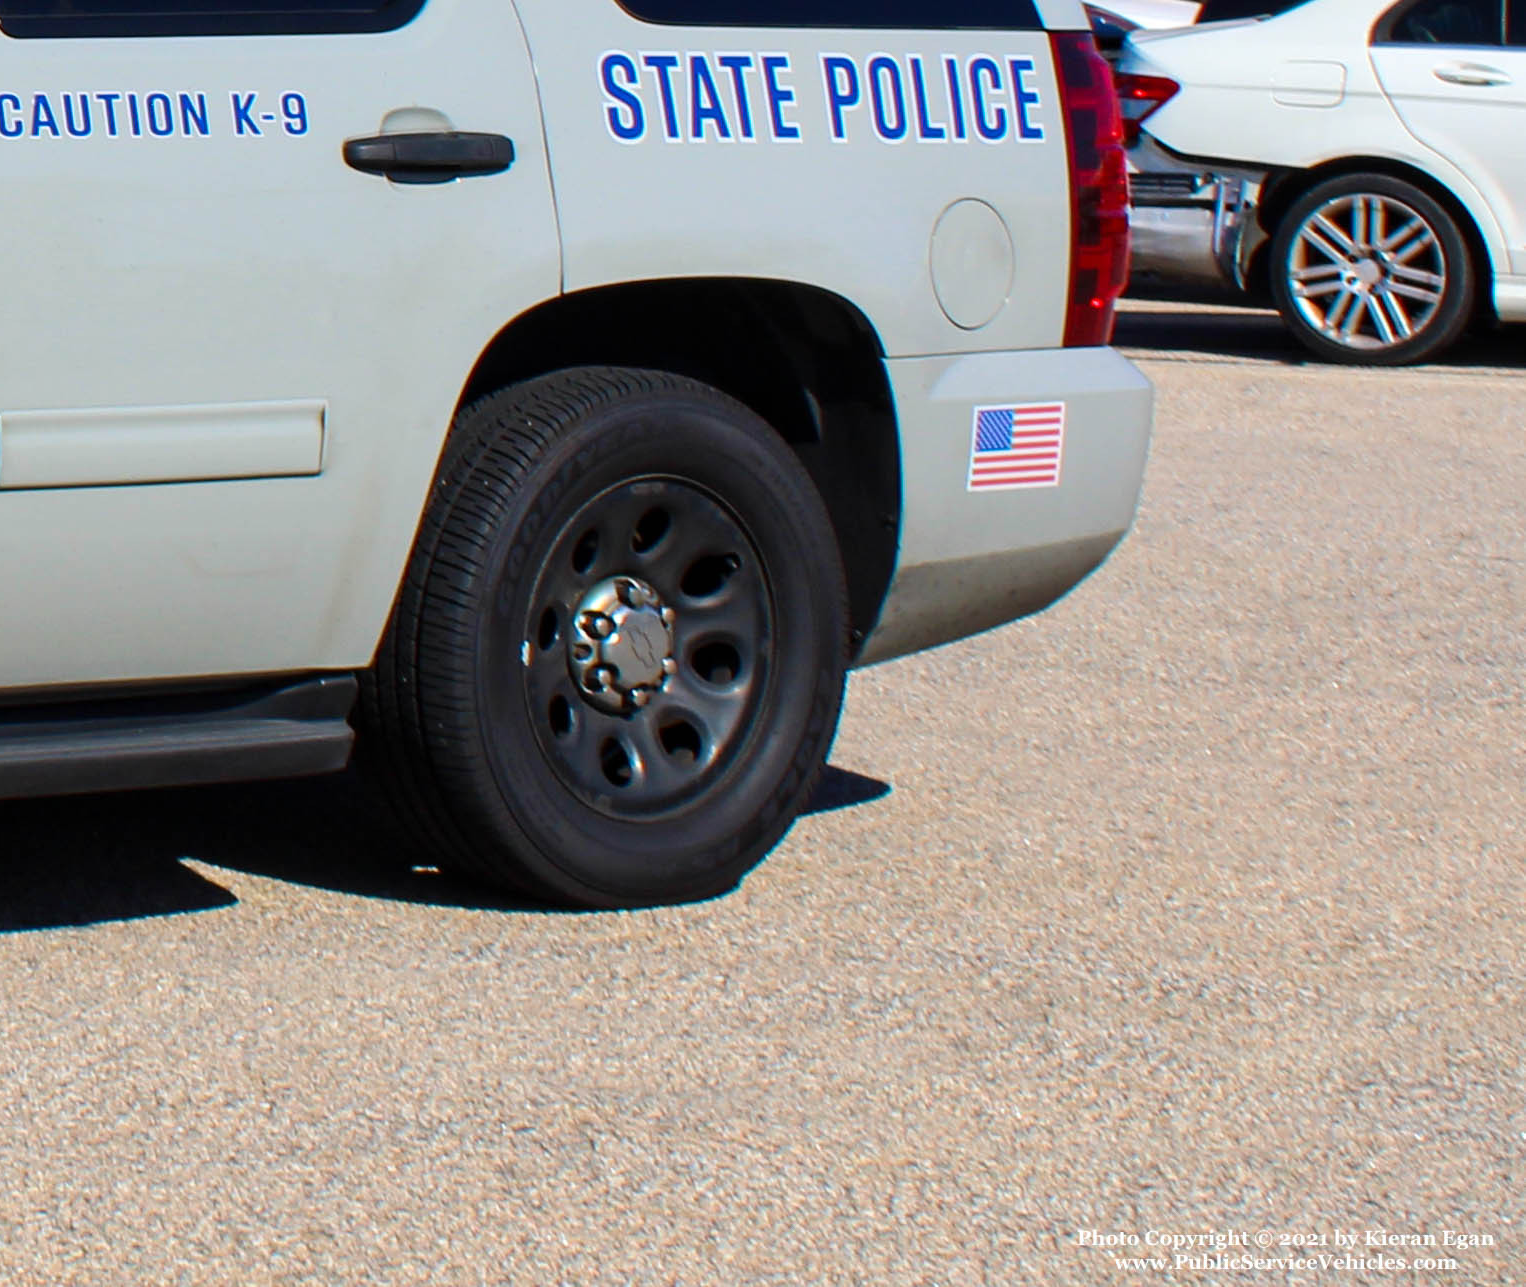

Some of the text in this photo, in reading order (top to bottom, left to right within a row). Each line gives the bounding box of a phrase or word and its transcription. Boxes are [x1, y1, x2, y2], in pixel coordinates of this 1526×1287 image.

[230, 91, 310, 137] K-9
[599, 52, 1046, 142] STATE POLICE
